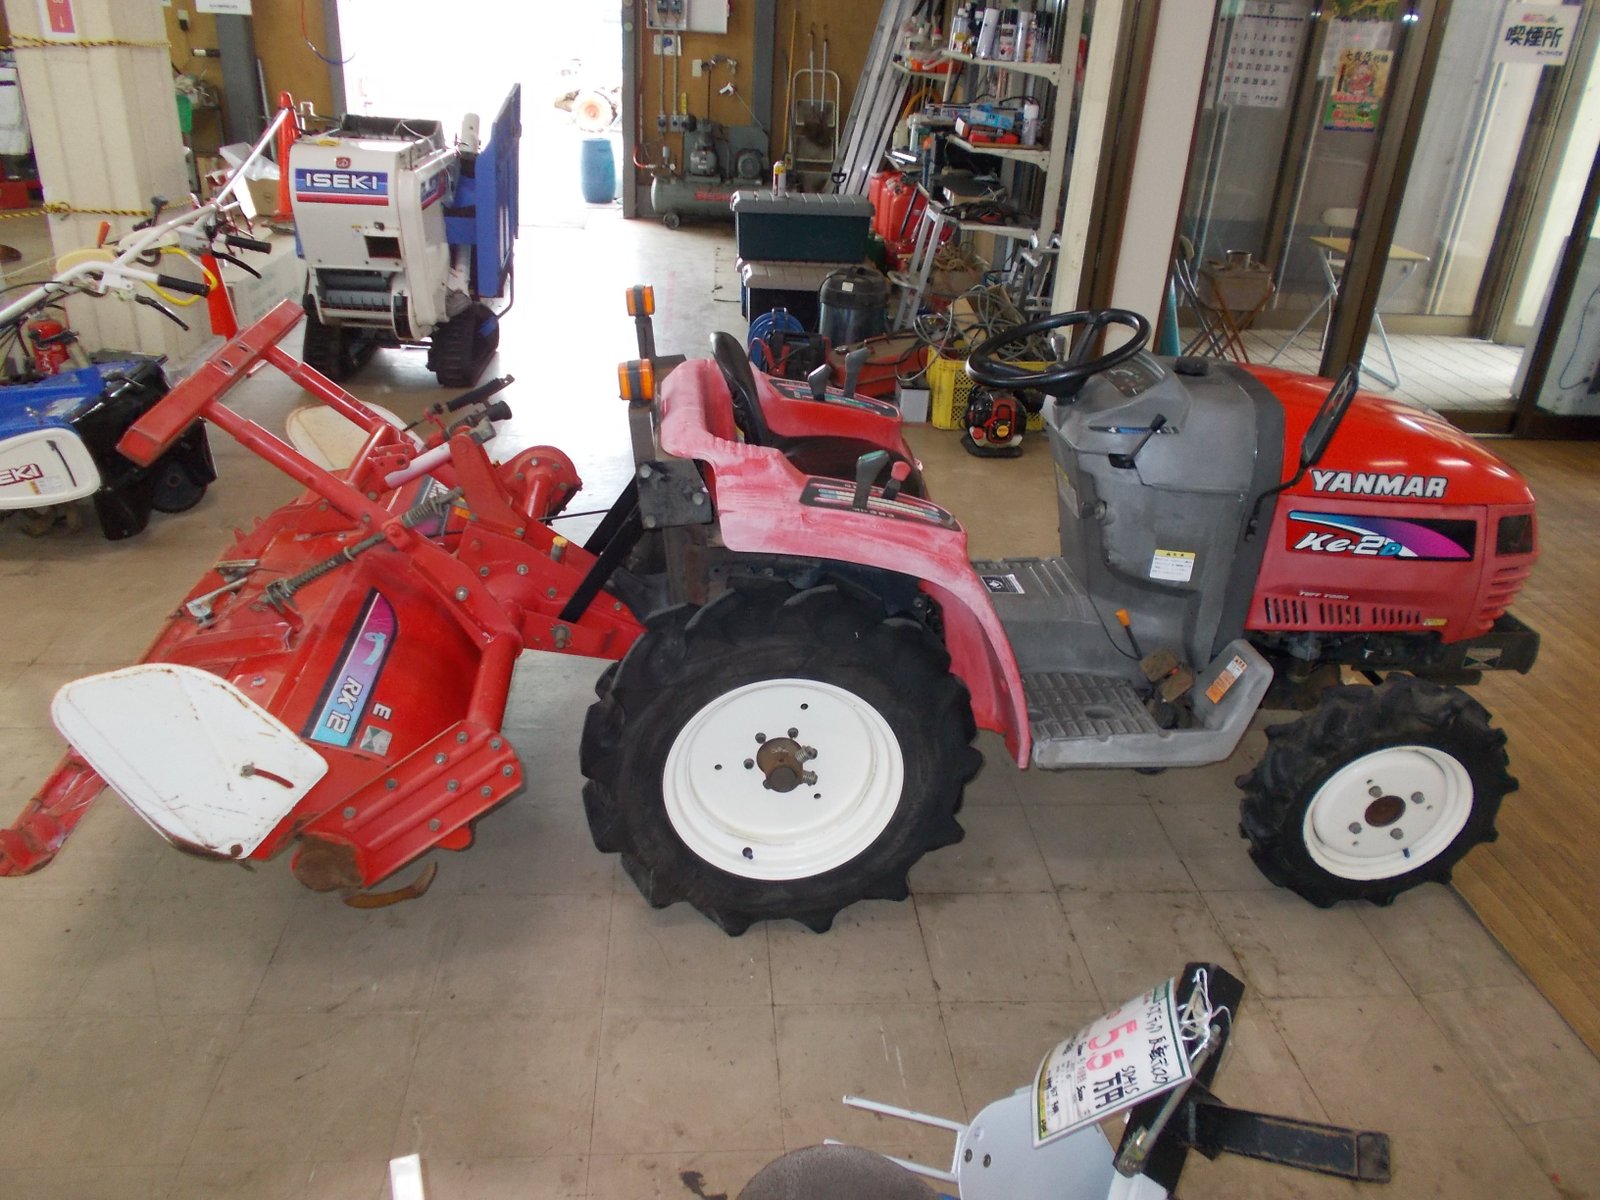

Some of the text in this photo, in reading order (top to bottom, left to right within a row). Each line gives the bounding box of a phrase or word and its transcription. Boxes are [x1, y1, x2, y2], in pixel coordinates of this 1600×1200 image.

[1504, 25, 1564, 48] 喫煙所
[304, 172, 378, 190] ISEKI
[1312, 469, 1448, 498] YANMAR
[325, 675, 364, 734] RK 12
[1093, 1071, 1125, 1109] 万円
